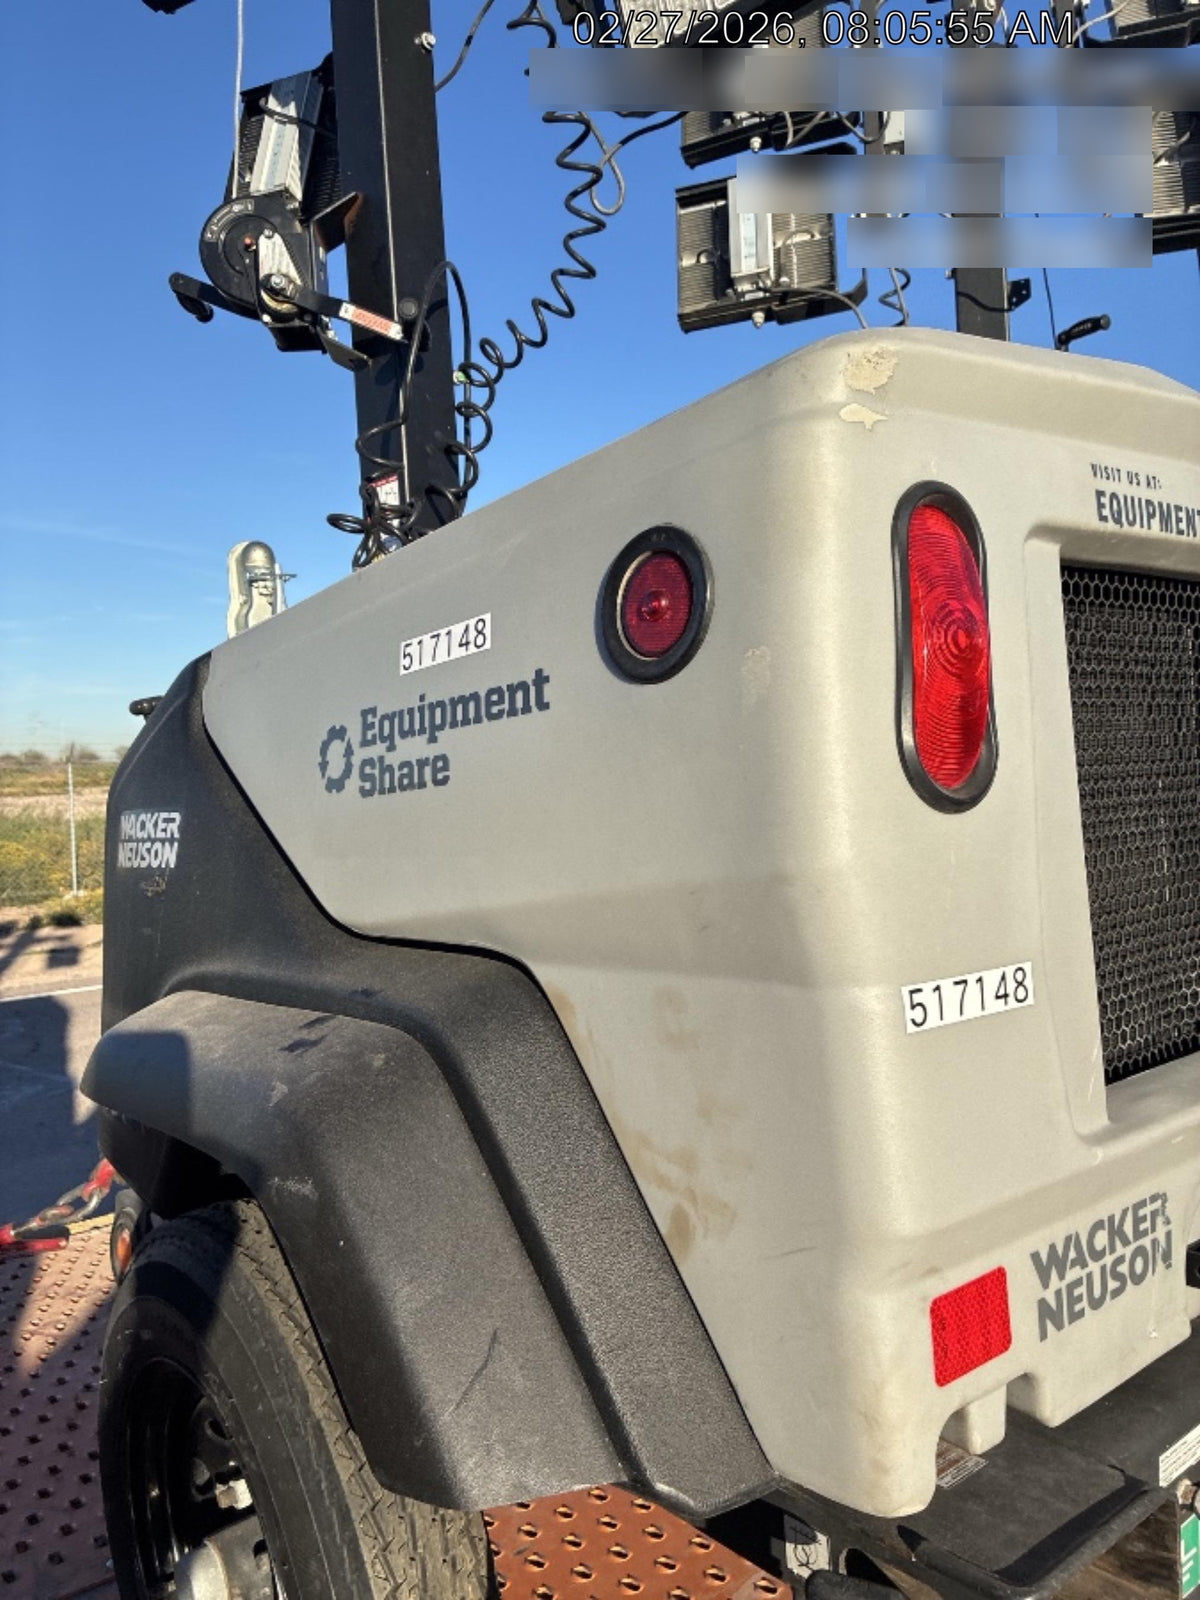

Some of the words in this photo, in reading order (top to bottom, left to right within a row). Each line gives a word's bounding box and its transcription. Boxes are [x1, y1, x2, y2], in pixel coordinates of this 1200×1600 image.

[1090, 462, 1121, 483] VISIT
[1126, 470, 1141, 487] US
[1146, 473, 1162, 490] AT:
[402, 618, 487, 671] 517148
[359, 667, 550, 753] Equipment
[358, 753, 450, 799] Share
[120, 812, 181, 839] WACKER
[117, 841, 179, 869] NEUSON
[908, 966, 1029, 1028] 517148
[1030, 1192, 1172, 1291] WACKER
[1037, 1229, 1173, 1343] NEUSON
